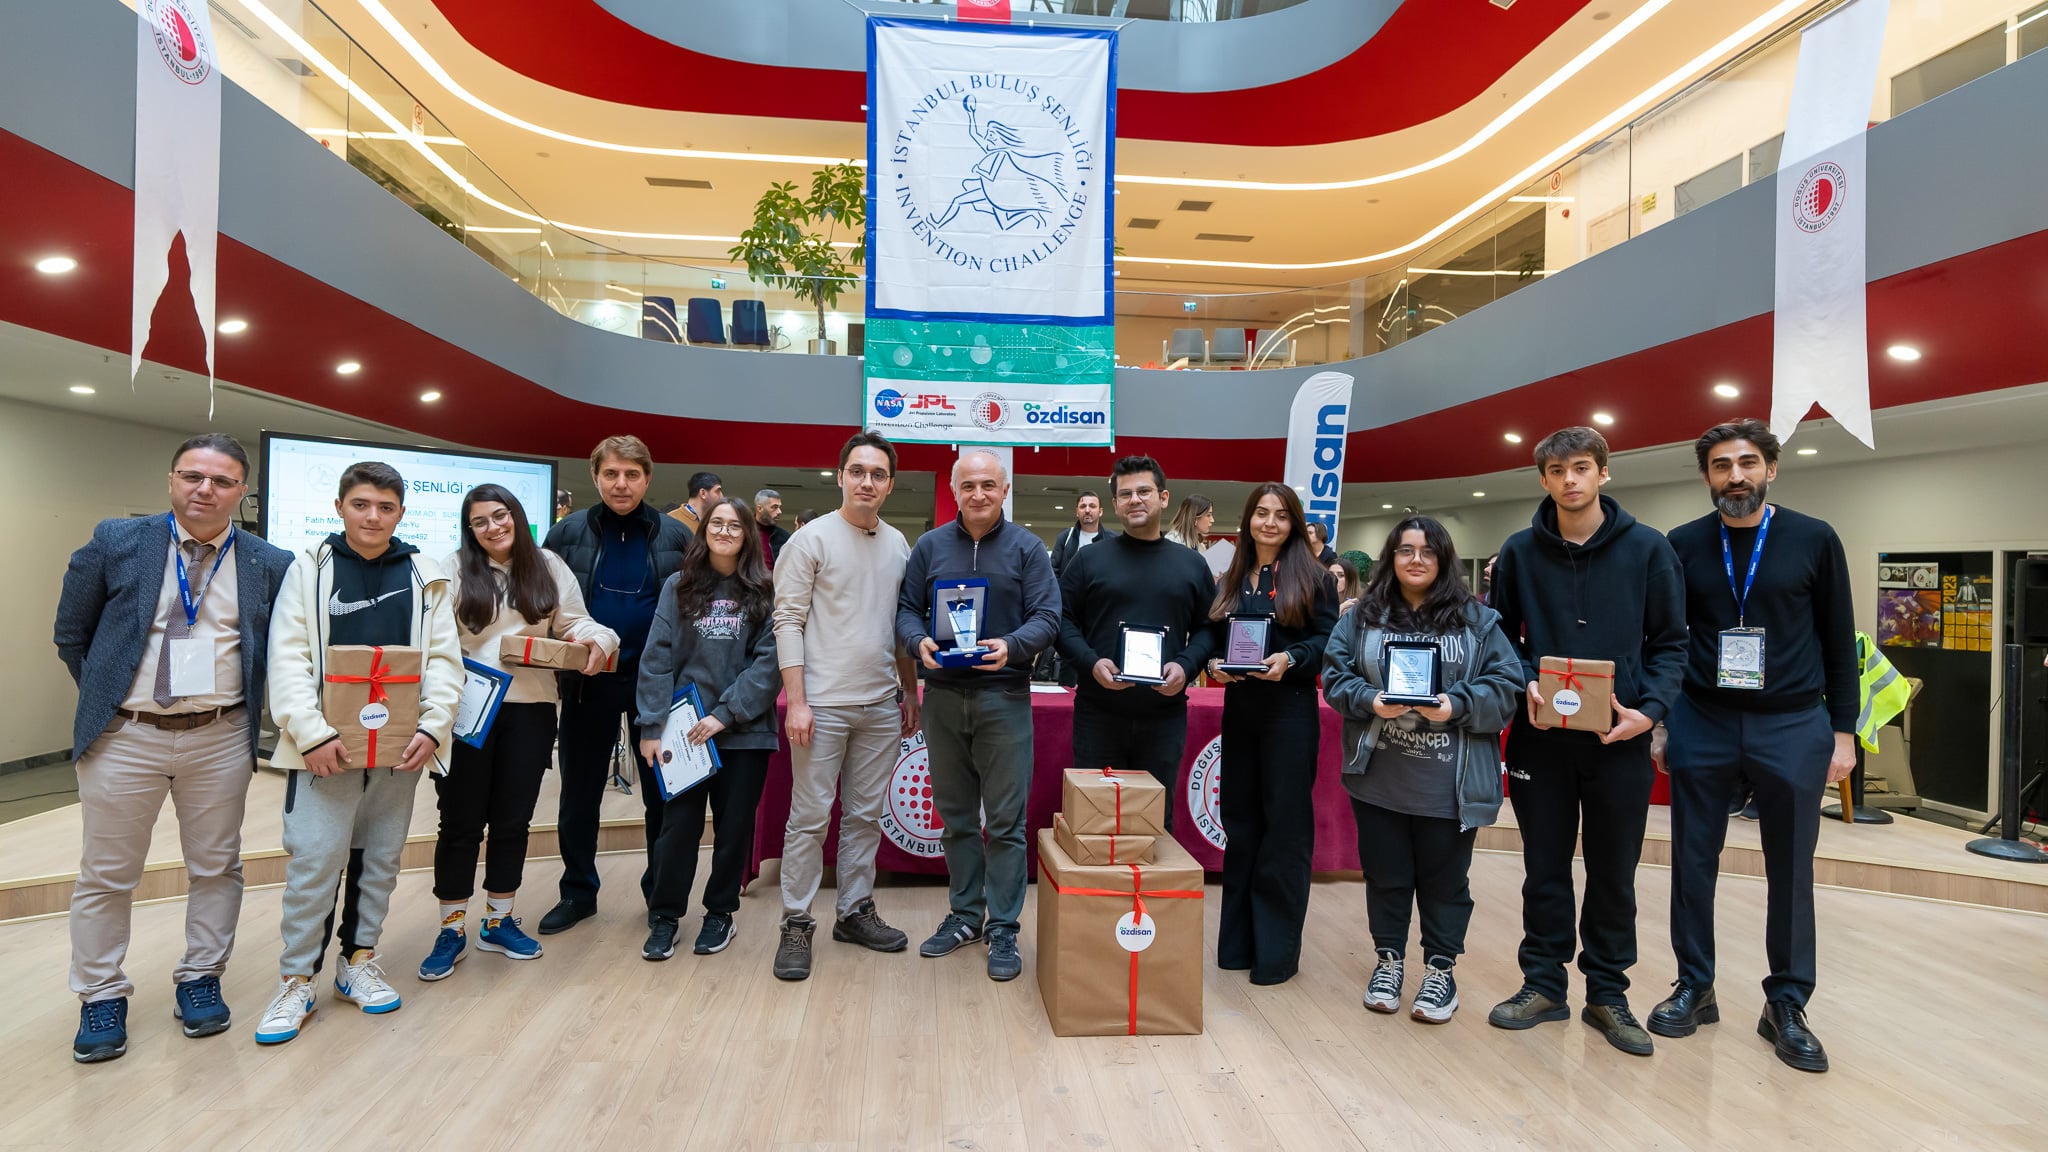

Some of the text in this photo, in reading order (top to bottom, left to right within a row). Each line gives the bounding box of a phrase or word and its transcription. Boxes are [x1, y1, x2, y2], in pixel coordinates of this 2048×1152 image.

[891, 74, 1093, 172] İSTANBUL BULUŞ ŞENLİĞİ
[896, 186, 1087, 273] INVENTION CHALLENGE
[877, 399, 902, 408] NASA
[909, 394, 956, 410] JPL
[1026, 403, 1105, 425] özdisan
[413, 480, 463, 494] ŞENLİĞİ
[1943, 575, 1957, 603] 2023
[1120, 926, 1152, 936] özdisan
